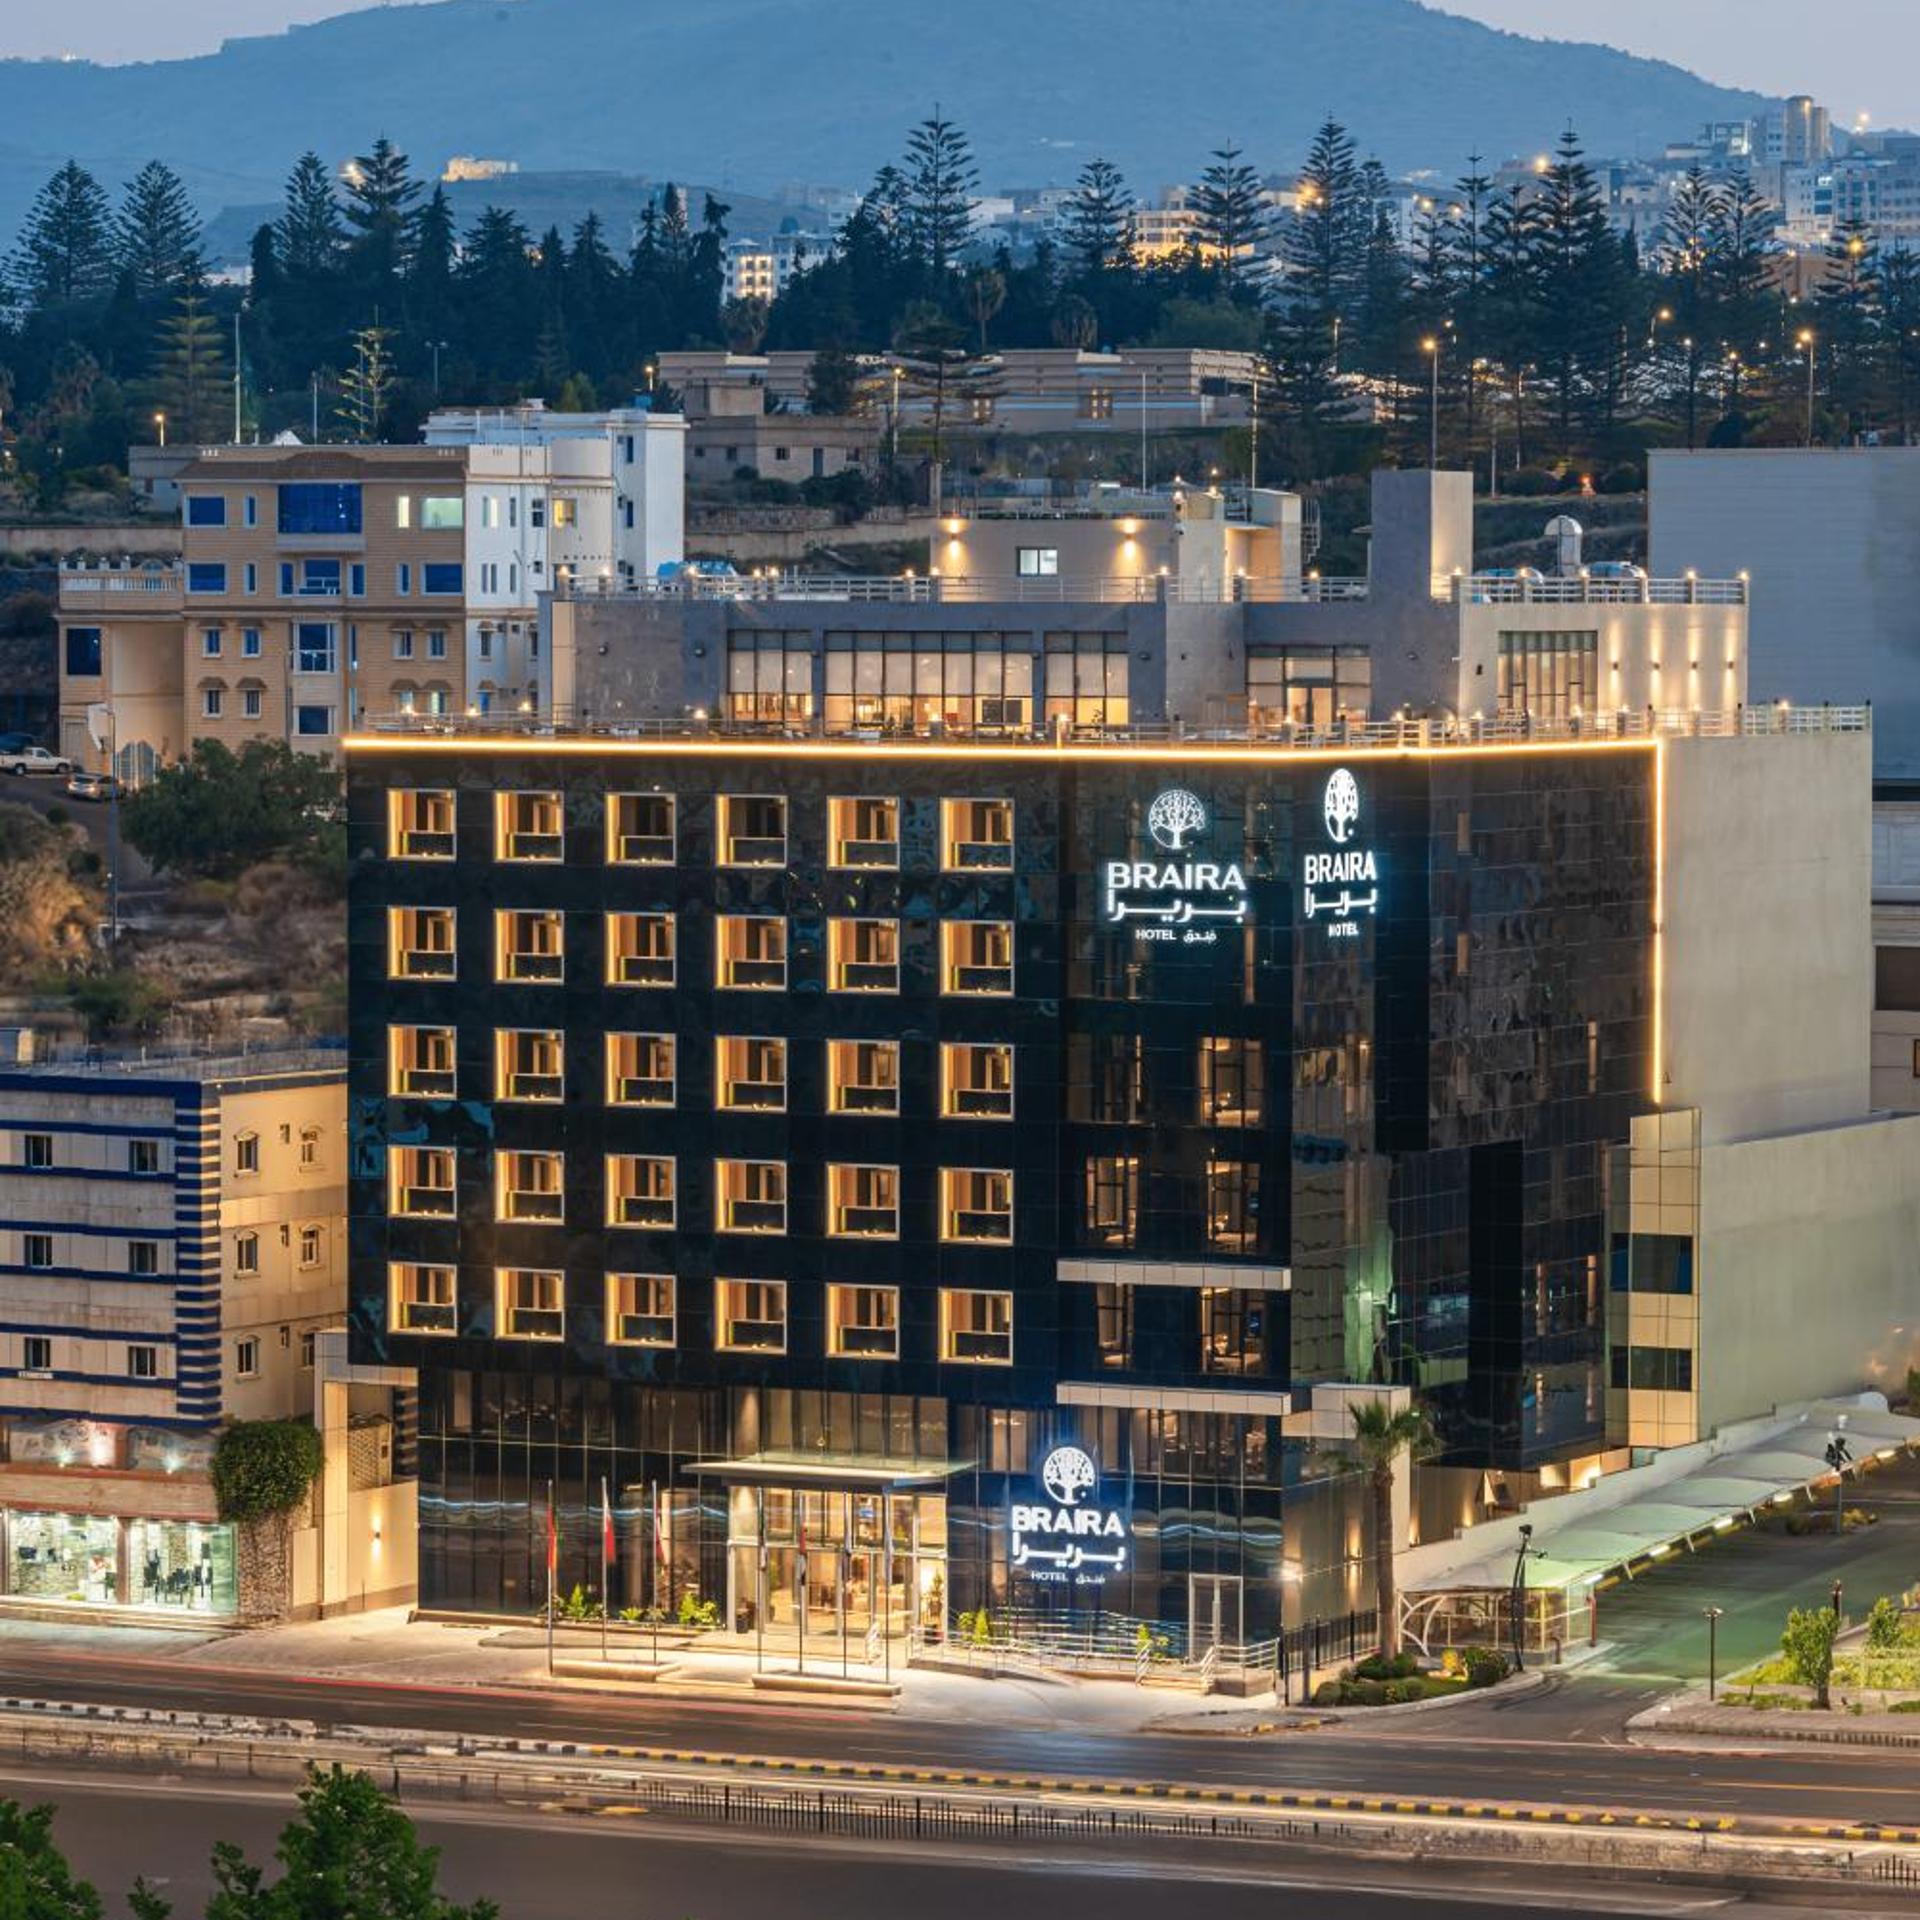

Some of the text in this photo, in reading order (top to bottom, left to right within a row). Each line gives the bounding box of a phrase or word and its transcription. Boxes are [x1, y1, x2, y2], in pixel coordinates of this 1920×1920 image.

[1107, 862, 1246, 891] BRAIRA
[1305, 851, 1377, 884] BRAIRA
[1107, 889, 1246, 923] بريرا
[1304, 887, 1378, 918] بريرا
[1135, 929, 1216, 944] HOTEL فندق
[1328, 922, 1359, 937] HOTEL
[1012, 1506, 1125, 1537] BRAIRA
[1012, 1531, 1125, 1571] بريرا
[1031, 1571, 1069, 1583] HOTEL
